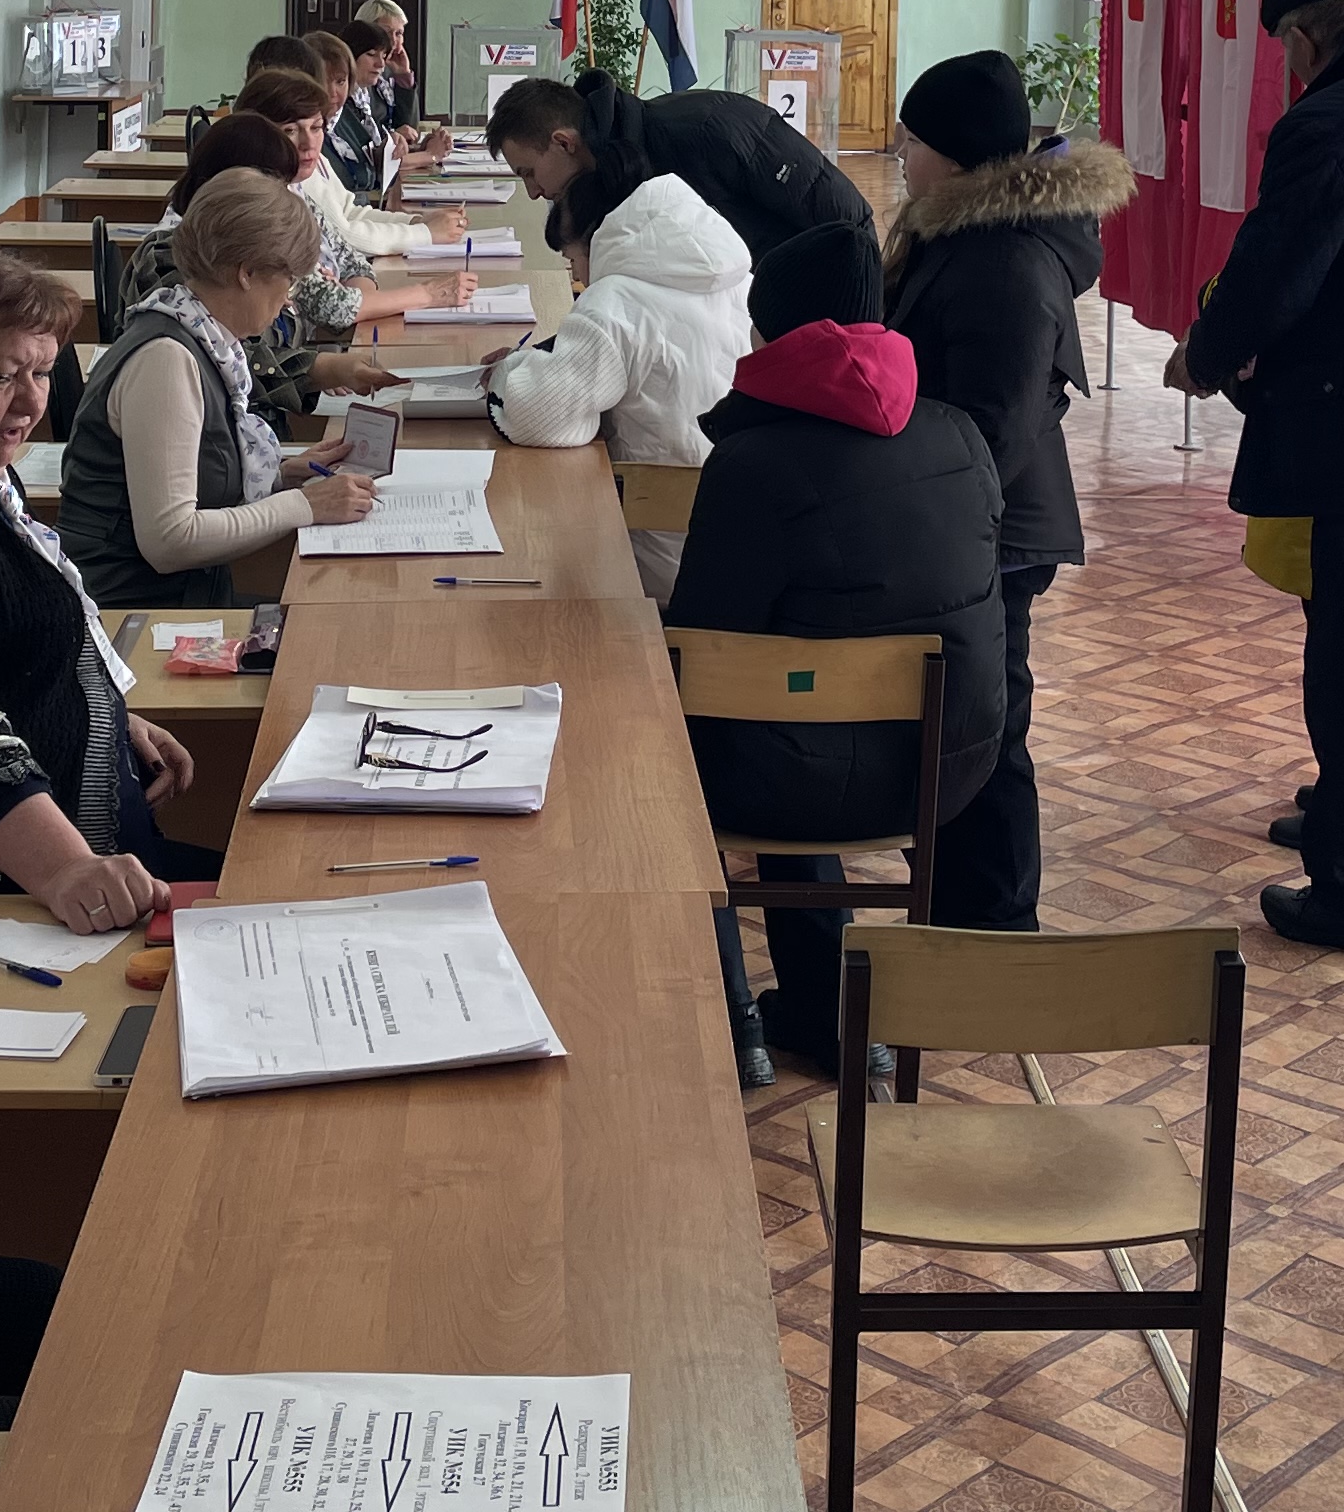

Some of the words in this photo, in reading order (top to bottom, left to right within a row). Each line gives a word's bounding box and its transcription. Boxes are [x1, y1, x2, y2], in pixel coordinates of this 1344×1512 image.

[70, 39, 77, 66] 1
[97, 37, 106, 61] 3
[780, 93, 795, 119] 2
[514, 1399, 532, 1434] Косарева
[291, 1426, 316, 1456] УИК
[422, 1410, 443, 1462] Спортивный
[446, 1428, 468, 1457] УИК
[600, 1425, 620, 1456] УИК
[282, 1457, 309, 1493] №555
[440, 1459, 463, 1494] №554
[473, 1476, 486, 1486] 27
[598, 1458, 619, 1492] №553
[574, 1480, 586, 1501] этаж
